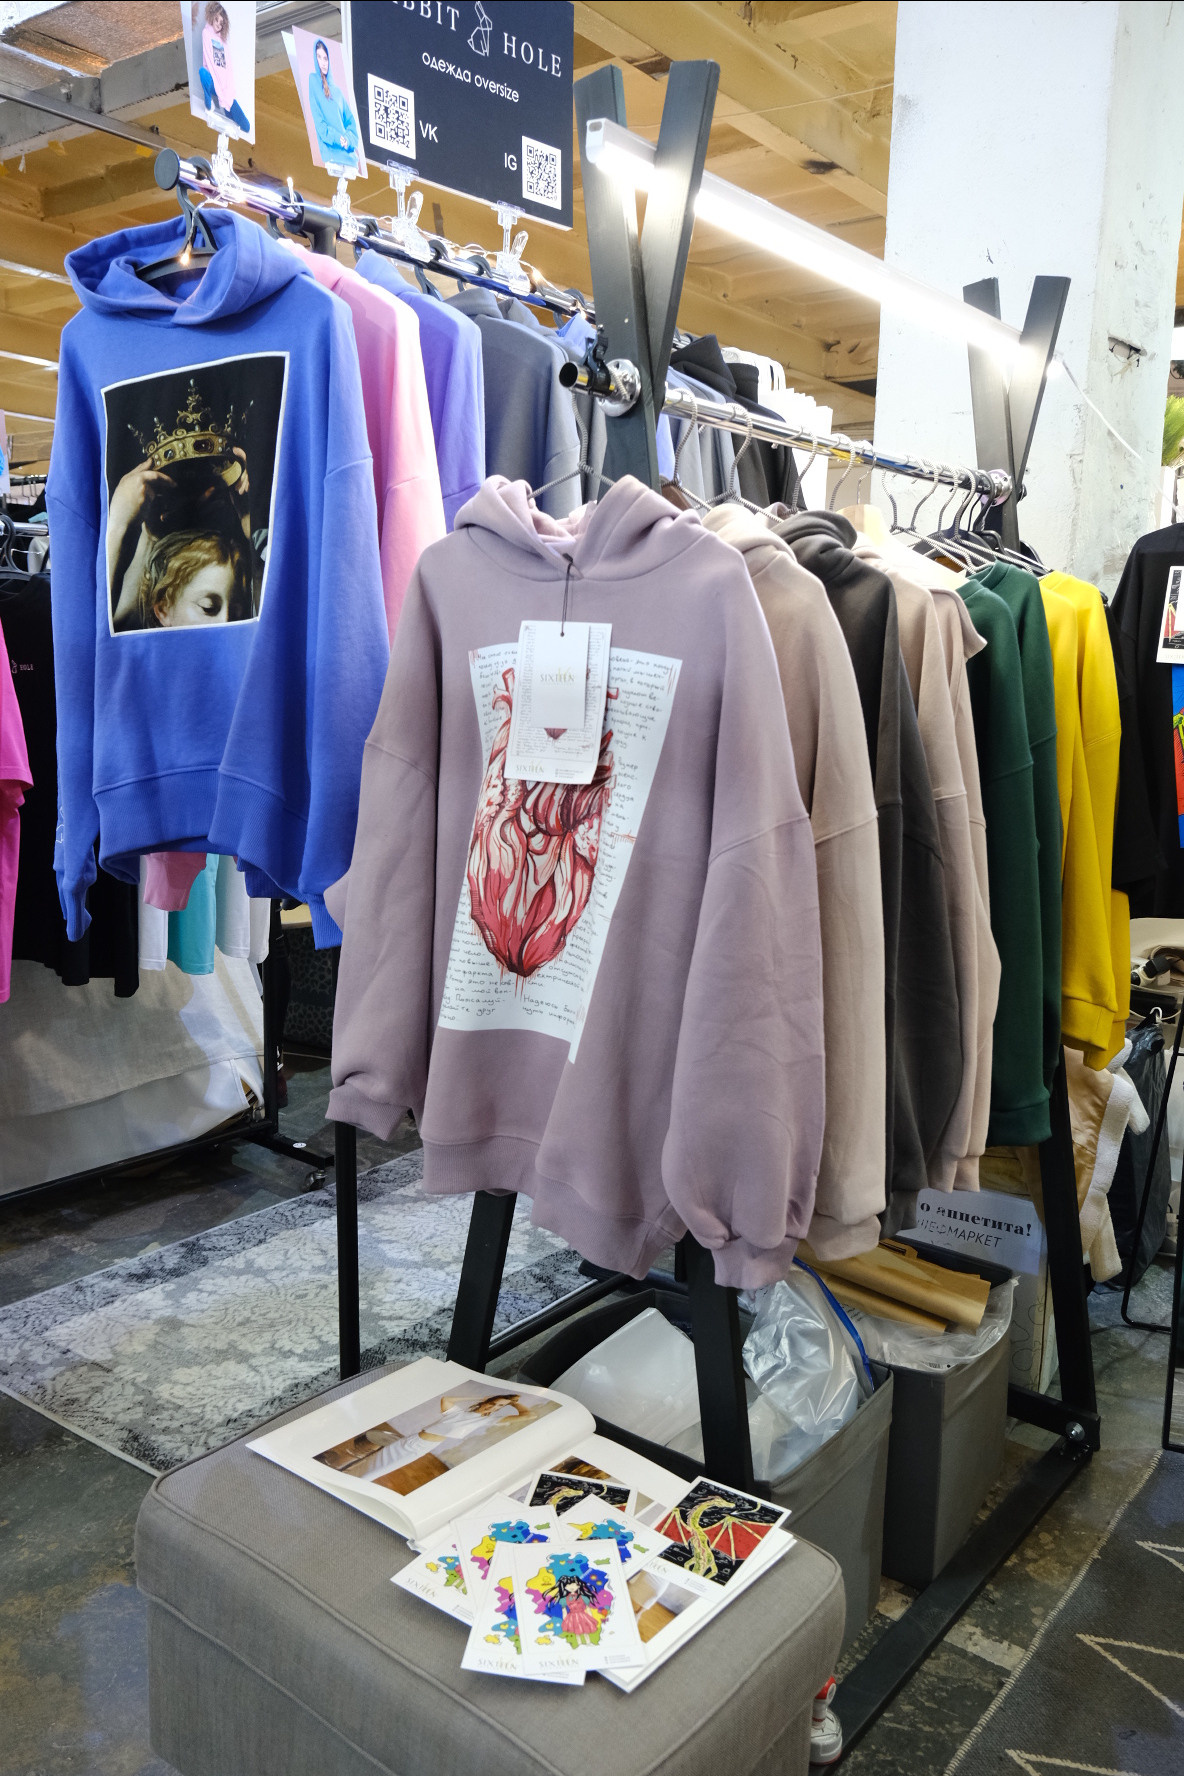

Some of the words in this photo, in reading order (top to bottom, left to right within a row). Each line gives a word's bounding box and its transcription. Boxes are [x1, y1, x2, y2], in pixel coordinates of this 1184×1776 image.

[393, 1, 460, 31] BBIT
[503, 32, 562, 78] HOLE
[422, 52, 472, 83] одежда
[474, 74, 520, 103] oversize
[418, 120, 439, 143] VK
[504, 152, 518, 171] IG
[936, 1206, 1032, 1237] аппетита!
